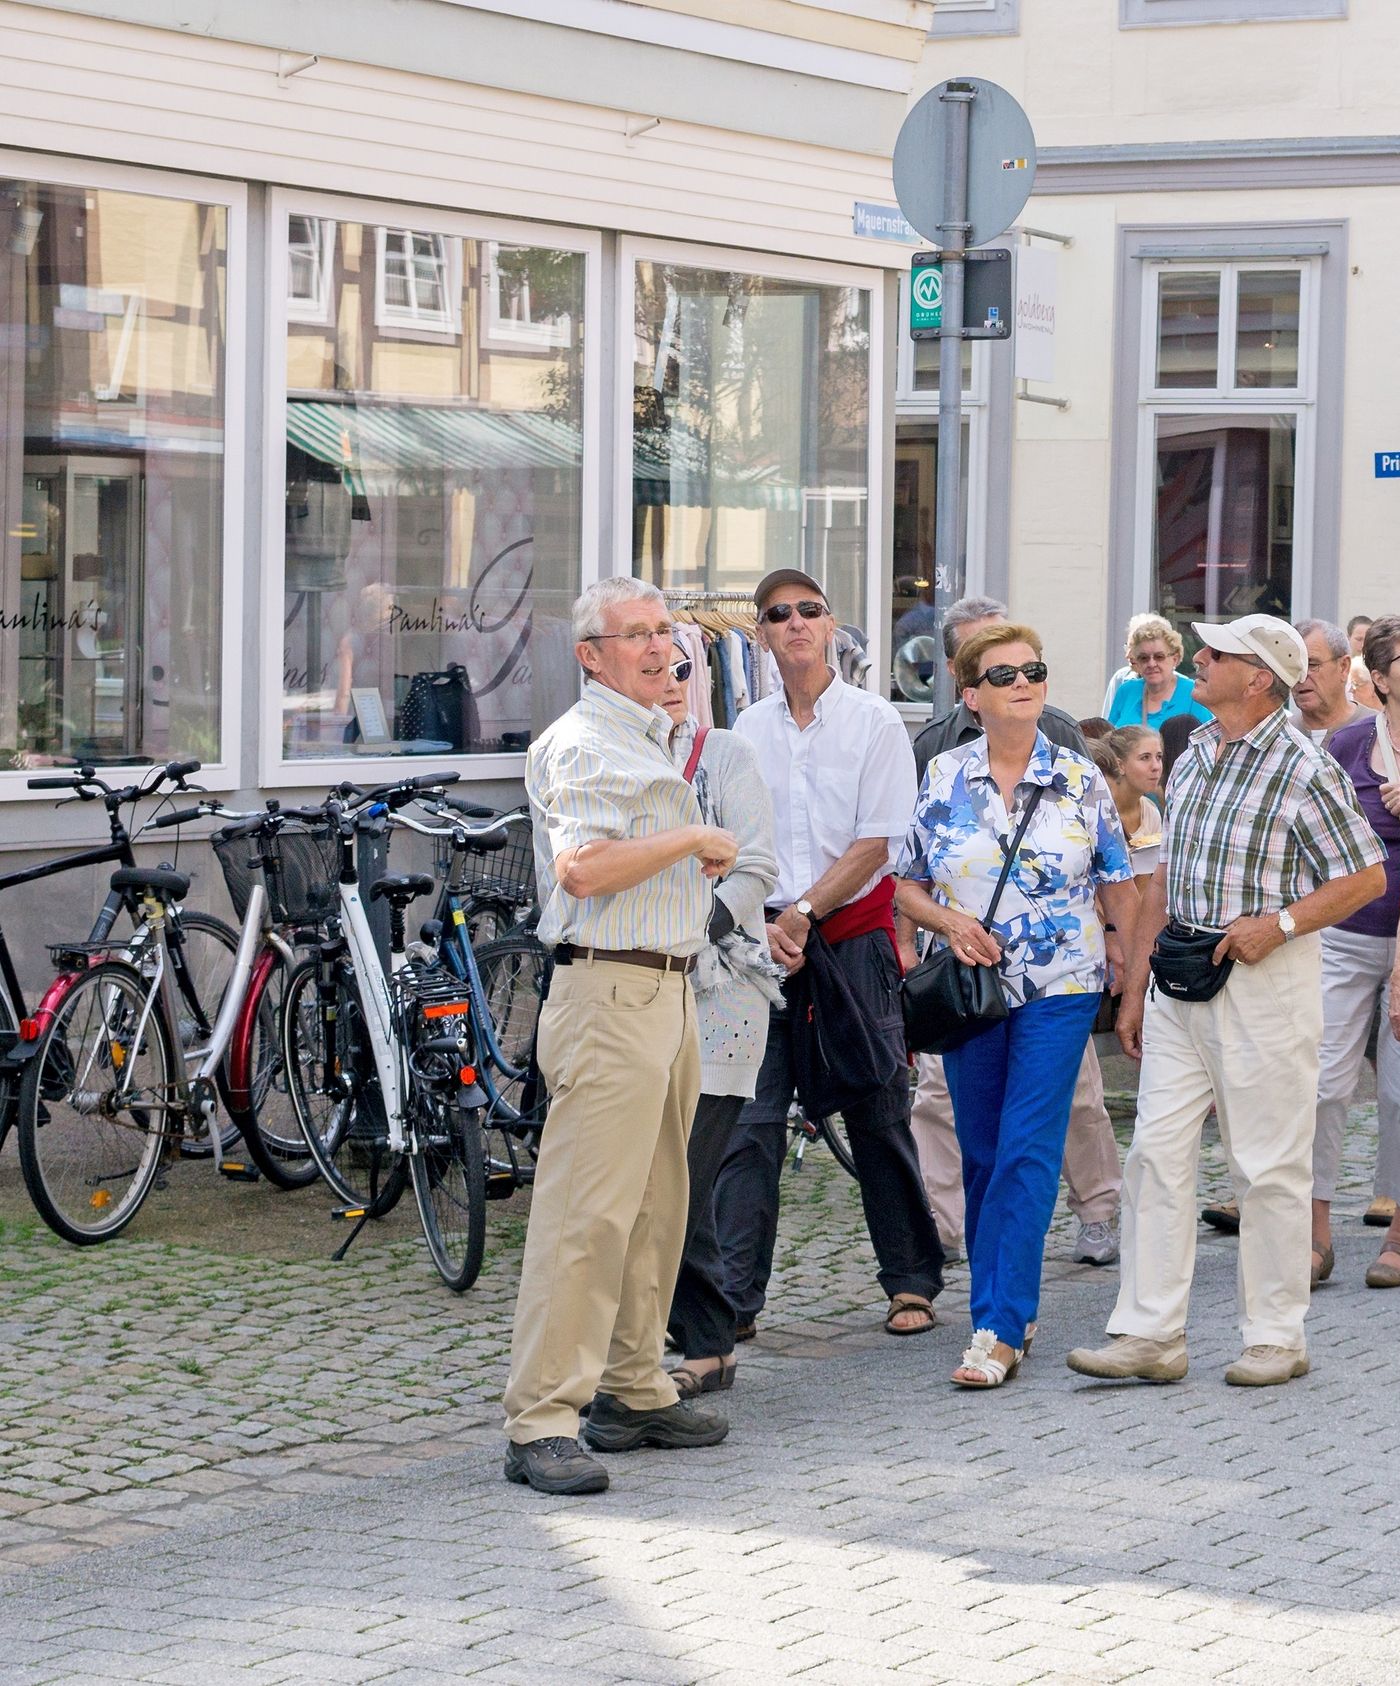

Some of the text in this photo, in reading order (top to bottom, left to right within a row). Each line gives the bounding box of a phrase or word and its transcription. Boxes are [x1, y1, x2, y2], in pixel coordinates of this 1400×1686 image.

[857, 207, 917, 236] Mauernstra
[0, 592, 101, 632] aulina's
[389, 597, 485, 634] Paulina's
